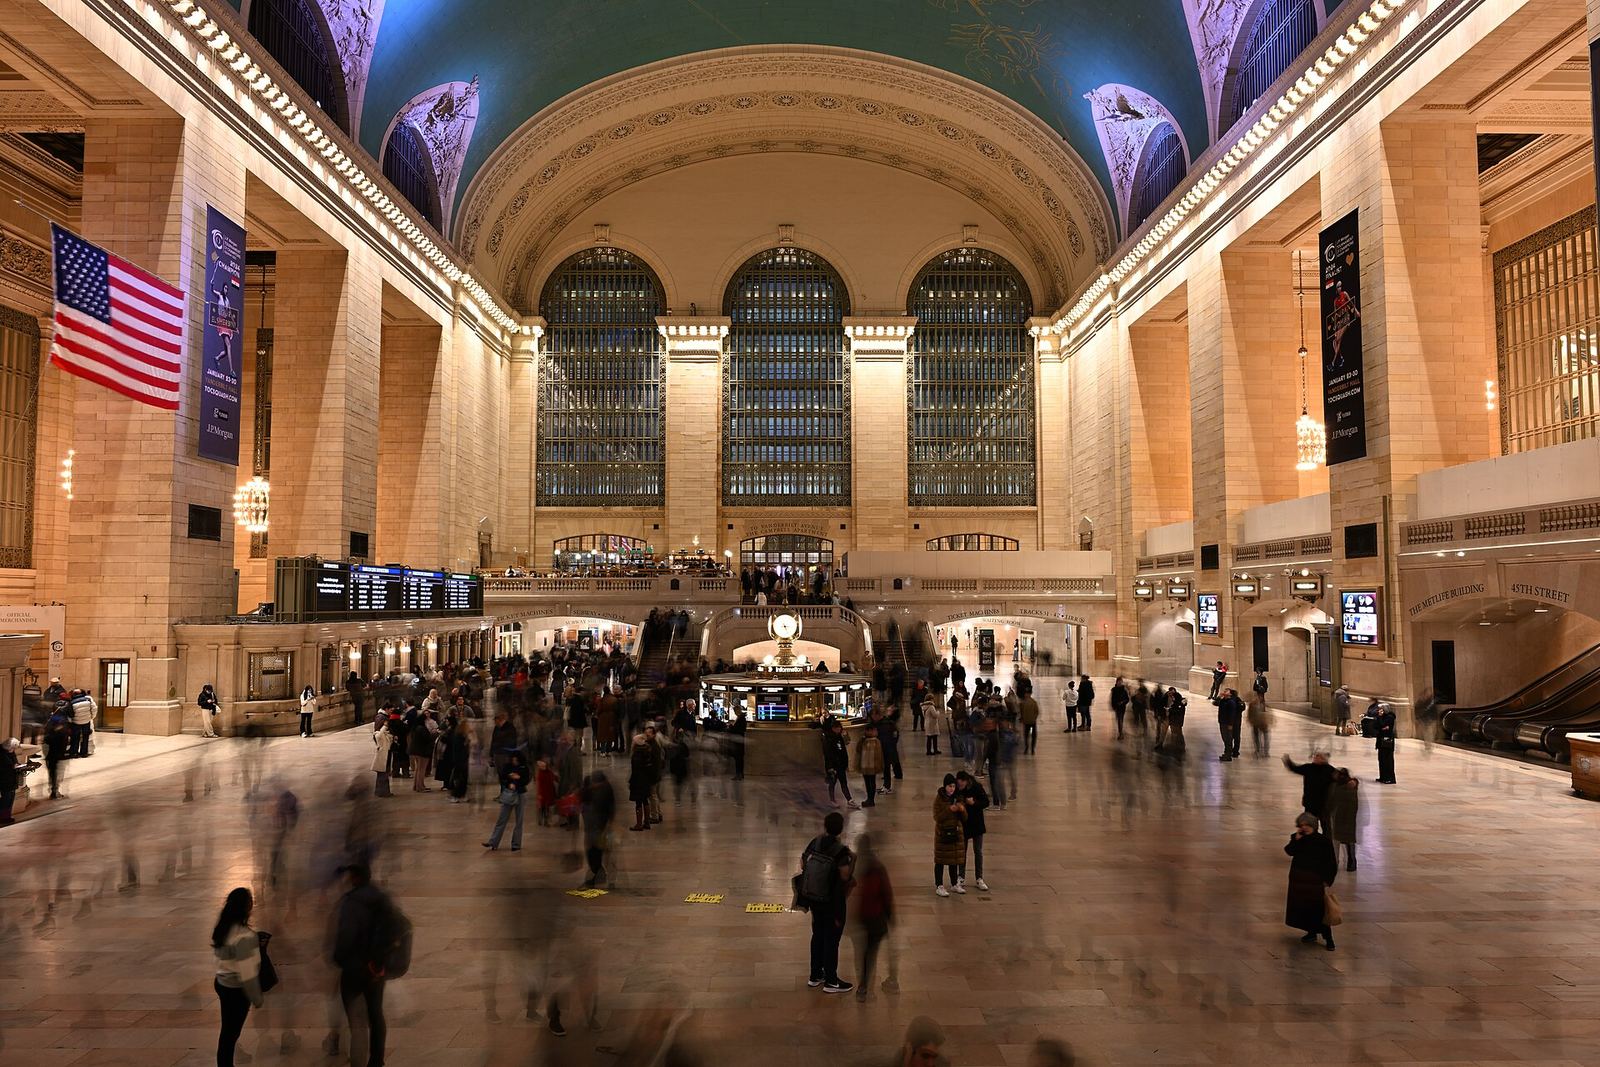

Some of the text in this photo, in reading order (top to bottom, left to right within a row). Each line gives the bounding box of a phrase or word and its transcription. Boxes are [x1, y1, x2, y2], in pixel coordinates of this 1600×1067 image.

[206, 368, 225, 380] JANUARY
[1328, 374, 1346, 387] JANUARY
[204, 385, 238, 403] TOCSQUASH.COM
[1327, 386, 1361, 404] TOCSQUASH.COM
[1408, 583, 1485, 617] THE METLIFE BUILDING
[1511, 583, 1570, 603] 45TH STREET
[496, 608, 553, 622] TICKET MACHINES
[947, 609, 1000, 620] TICKET MACHINES
[1019, 608, 1042, 616] TRACKS
